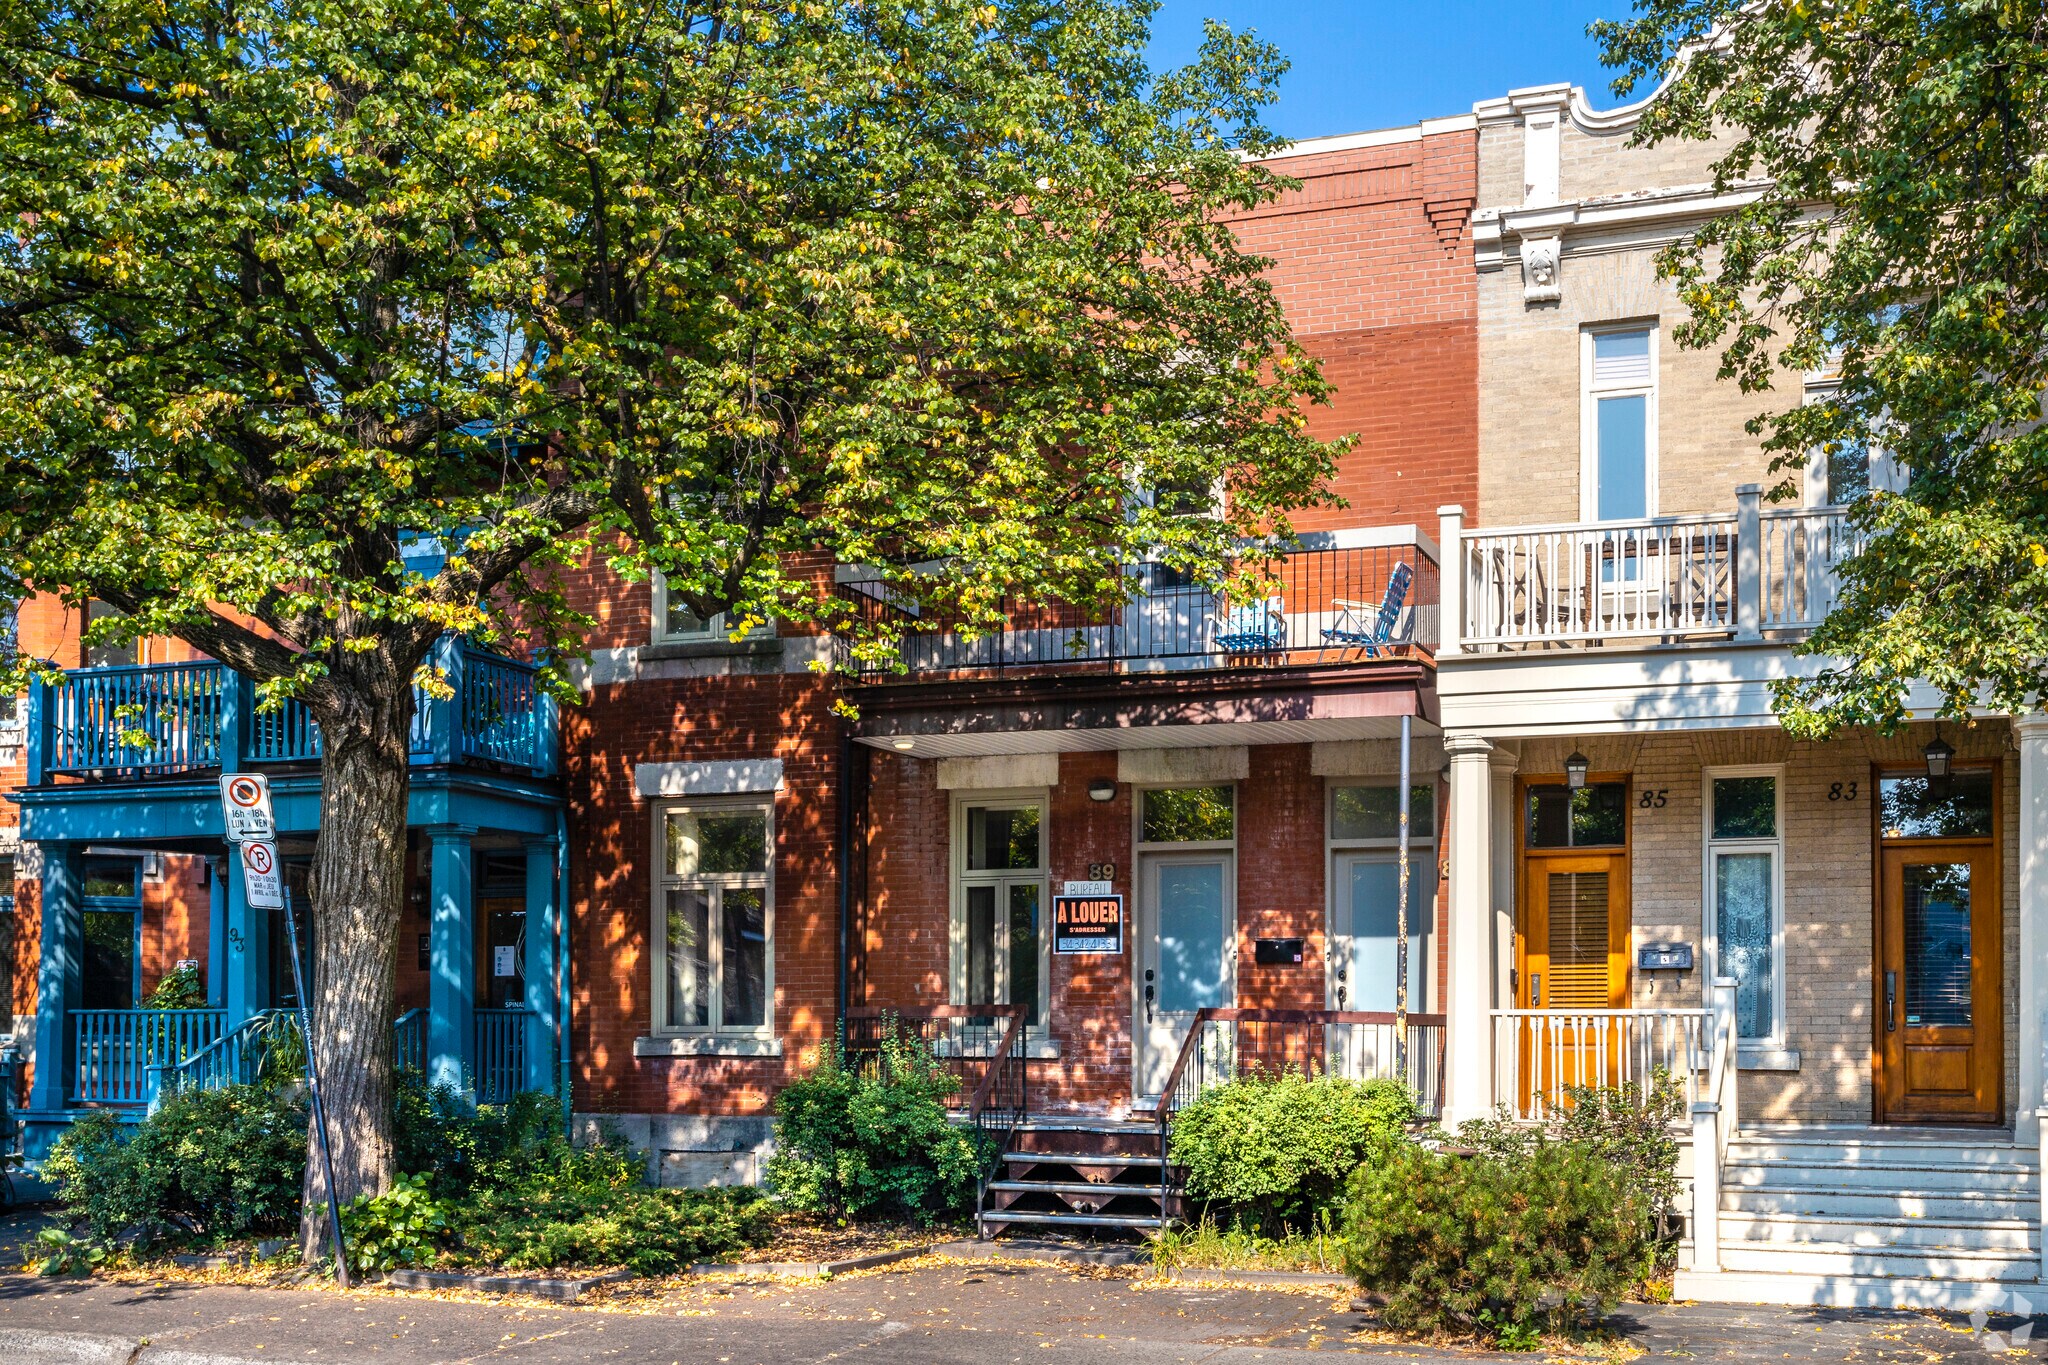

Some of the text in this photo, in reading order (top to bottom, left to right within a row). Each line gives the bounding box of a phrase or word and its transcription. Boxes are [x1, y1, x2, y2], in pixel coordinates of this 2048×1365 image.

[1639, 790, 1669, 809] 85
[1827, 782, 1858, 801] 83
[232, 809, 245, 818] 16h
[251, 808, 265, 818] 18h
[231, 819, 245, 828] LUN
[254, 819, 268, 827] VEN
[1089, 864, 1115, 880] 89
[1070, 883, 1106, 895] BUREAU
[1071, 902, 1118, 923] LOUER
[230, 928, 244, 952] 93
